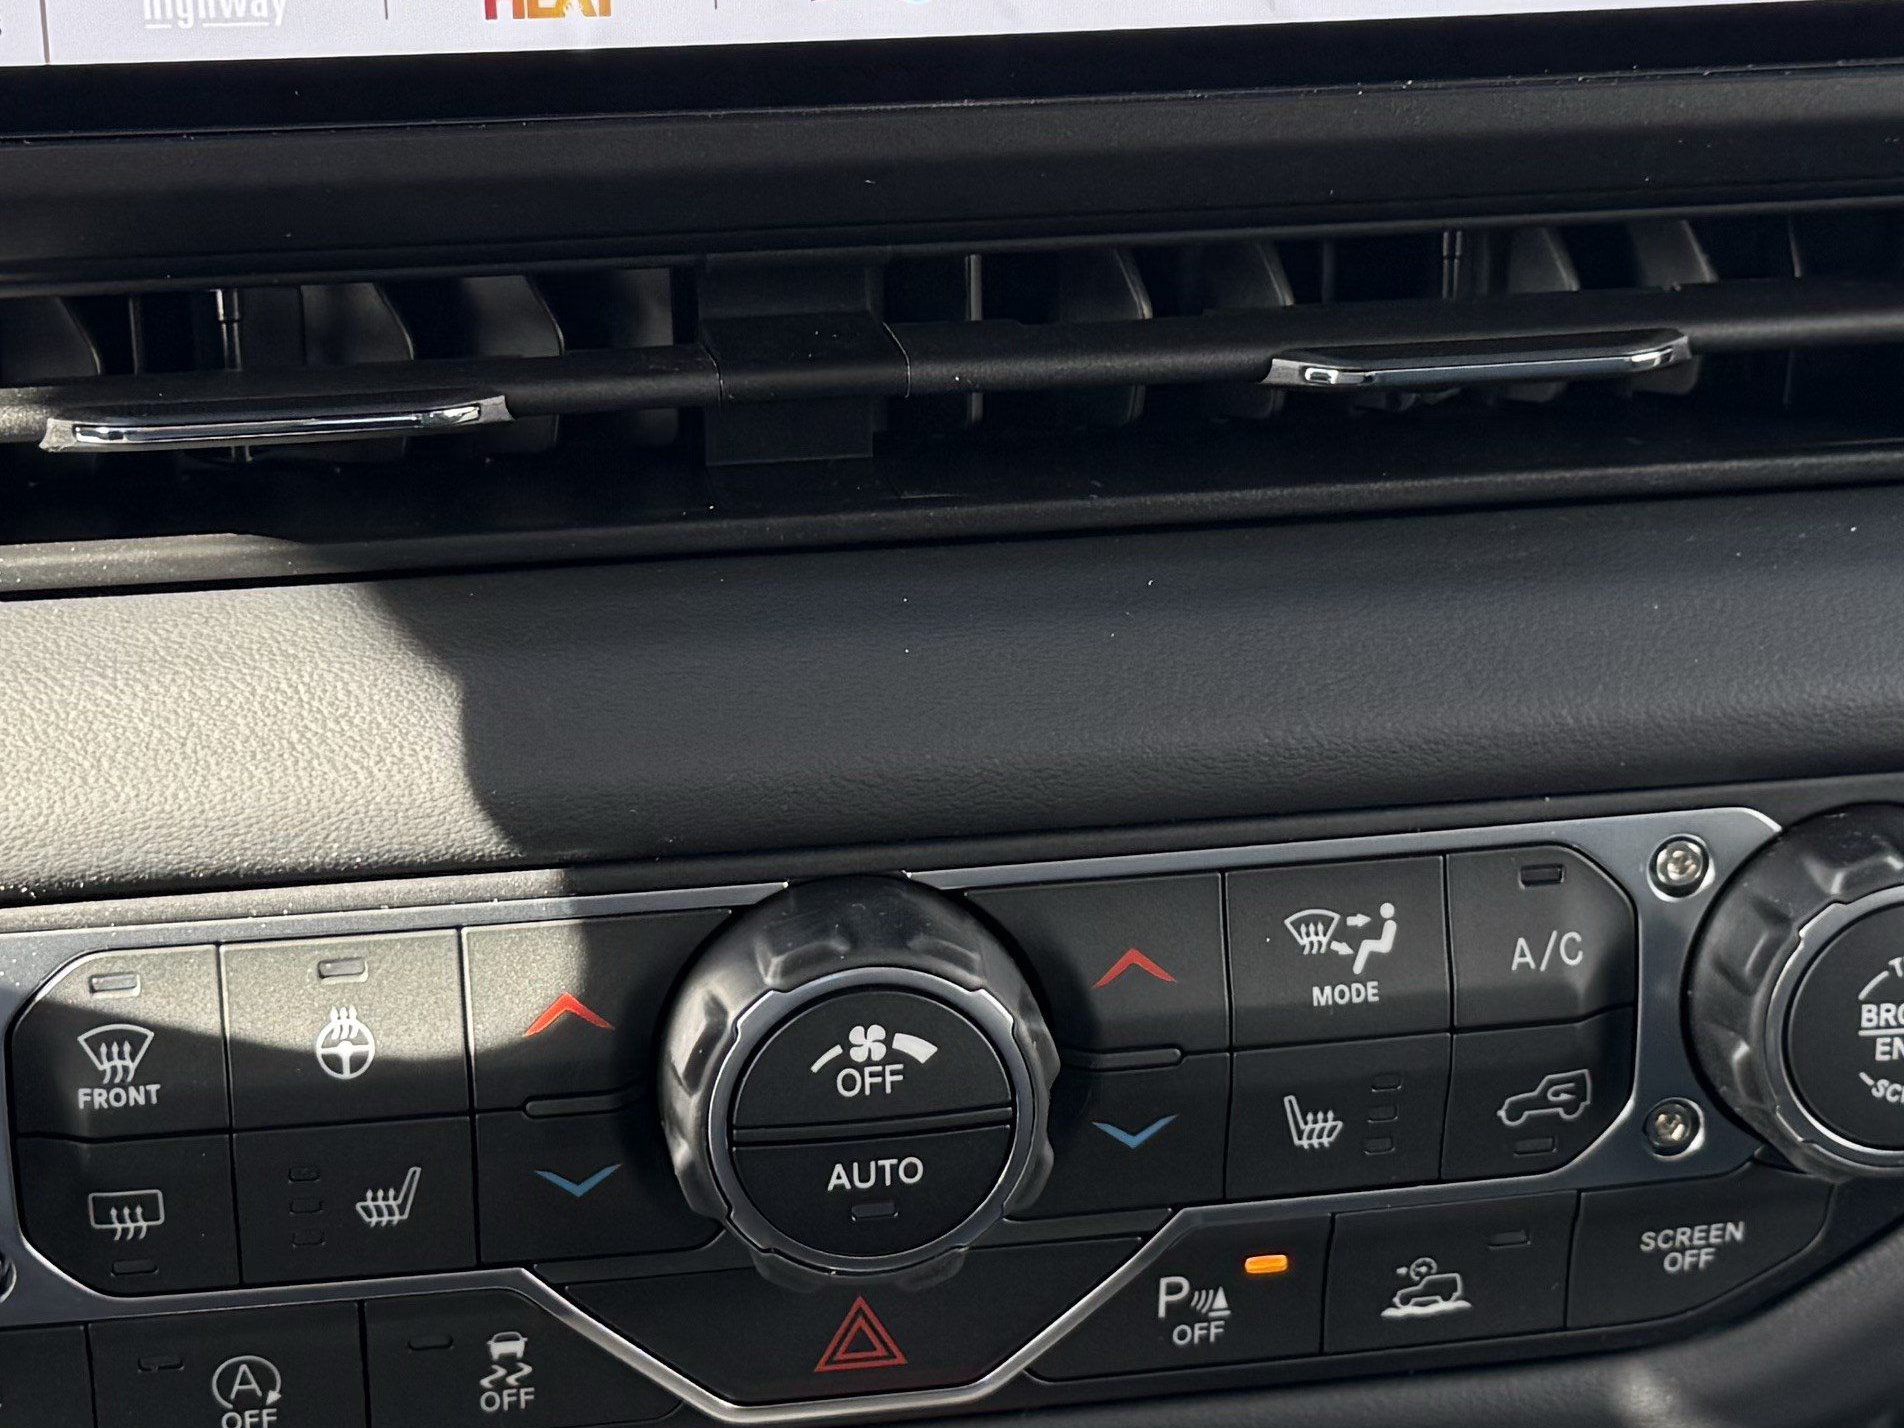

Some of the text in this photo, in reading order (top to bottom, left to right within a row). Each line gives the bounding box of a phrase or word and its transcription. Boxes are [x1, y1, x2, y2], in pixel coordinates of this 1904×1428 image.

[1511, 930, 1584, 972] A/C
[1311, 981, 1380, 1007] MODE
[835, 1062, 904, 1098] OFF
[77, 1083, 162, 1111] FRONT
[826, 1155, 925, 1192] AUTO
[1638, 1218, 1745, 1255] SCREEN
[1662, 1244, 1716, 1275] OFF
[1157, 1276, 1191, 1320] P
[1171, 1321, 1226, 1347] OFF
[479, 1387, 536, 1413] OFF
